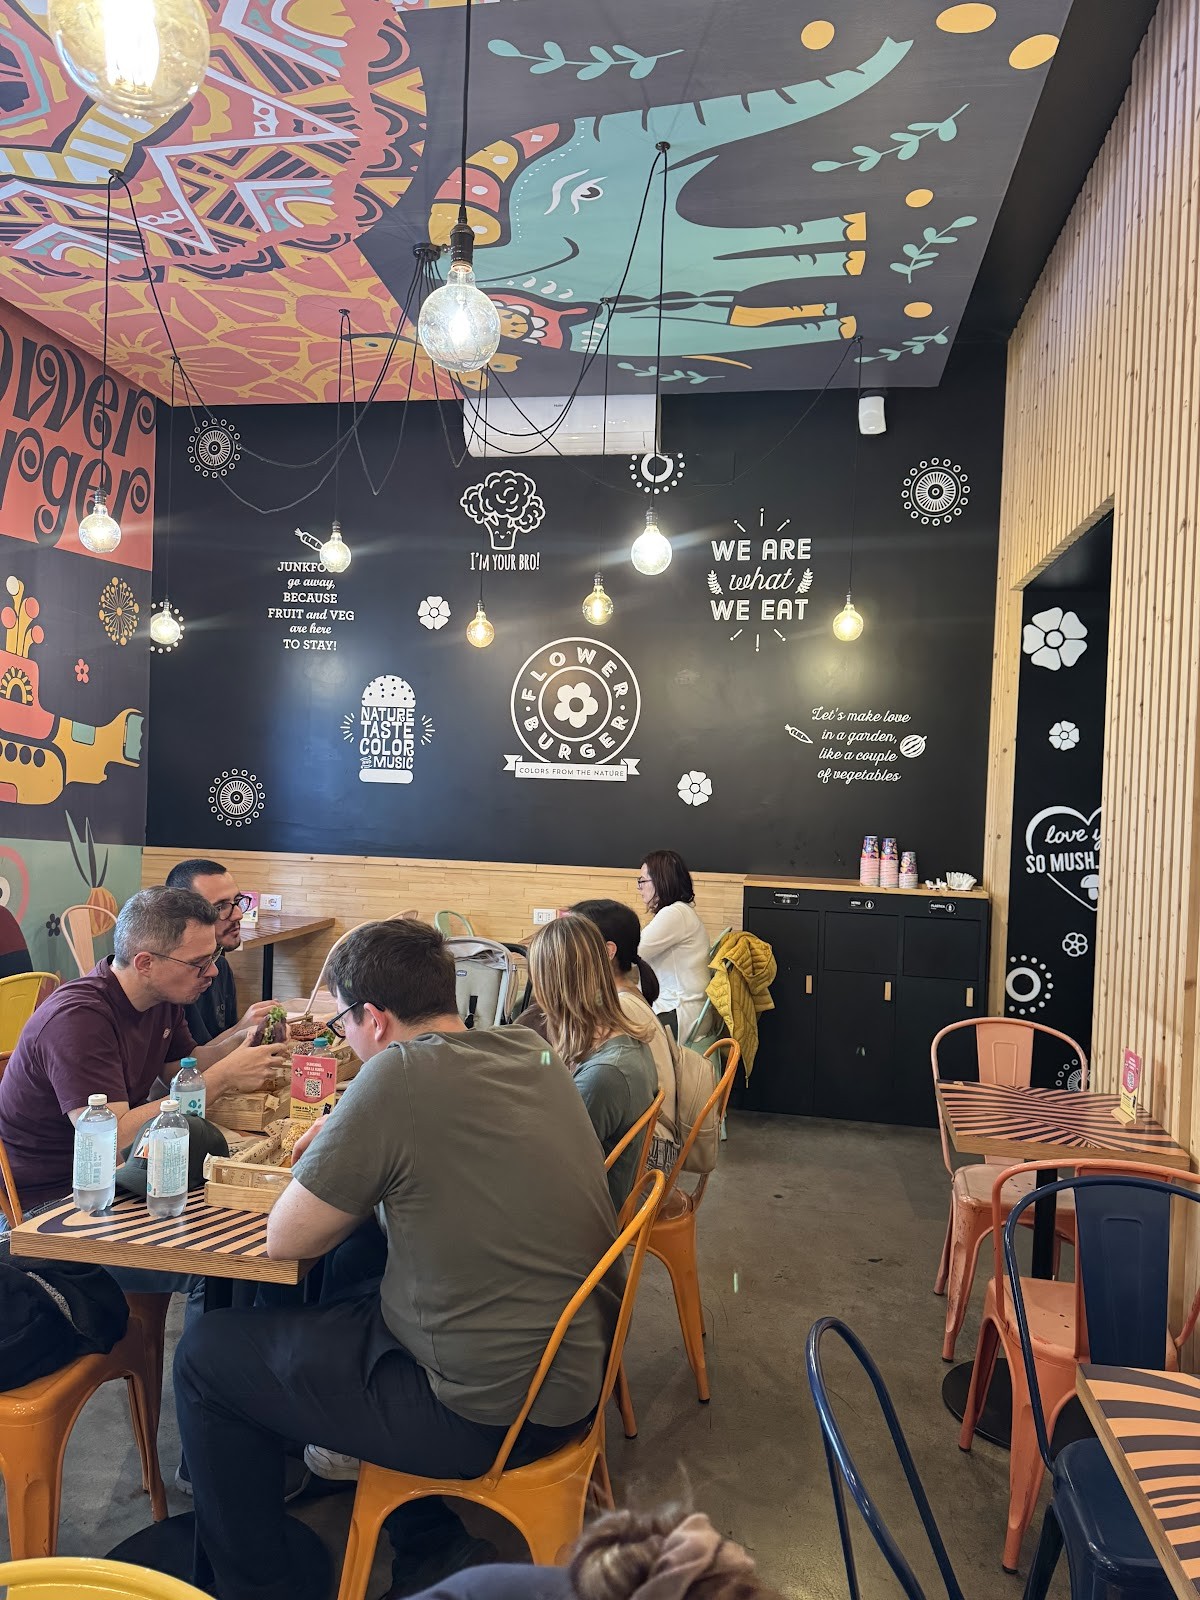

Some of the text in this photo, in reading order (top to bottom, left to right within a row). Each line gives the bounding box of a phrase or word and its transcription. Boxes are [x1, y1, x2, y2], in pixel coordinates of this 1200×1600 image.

[711, 538, 811, 561] WE ARE
[277, 562, 328, 573] JUNKFO
[469, 552, 540, 572] I'M YOUR BRO!
[287, 578, 336, 590] go away,
[729, 566, 795, 590] what
[283, 592, 338, 603] BECAUSE
[267, 608, 355, 620] FRUIT and VEG
[710, 599, 809, 620] WE EAT
[289, 622, 332, 634] are here
[282, 639, 337, 651] TO STAY!
[521, 646, 629, 701] FLOWER
[361, 707, 415, 722] NATURE
[811, 706, 912, 723] Let's make love
[360, 721, 415, 739] TASTE
[523, 715, 629, 761] BURGER
[821, 729, 898, 745] in a garden,
[360, 738, 415, 756] COLOR
[373, 756, 414, 769] MUSIC
[818, 747, 899, 766] like a couple
[817, 768, 902, 785] of vegetables
[1044, 824, 1089, 844] love
[1025, 854, 1046, 874] SO
